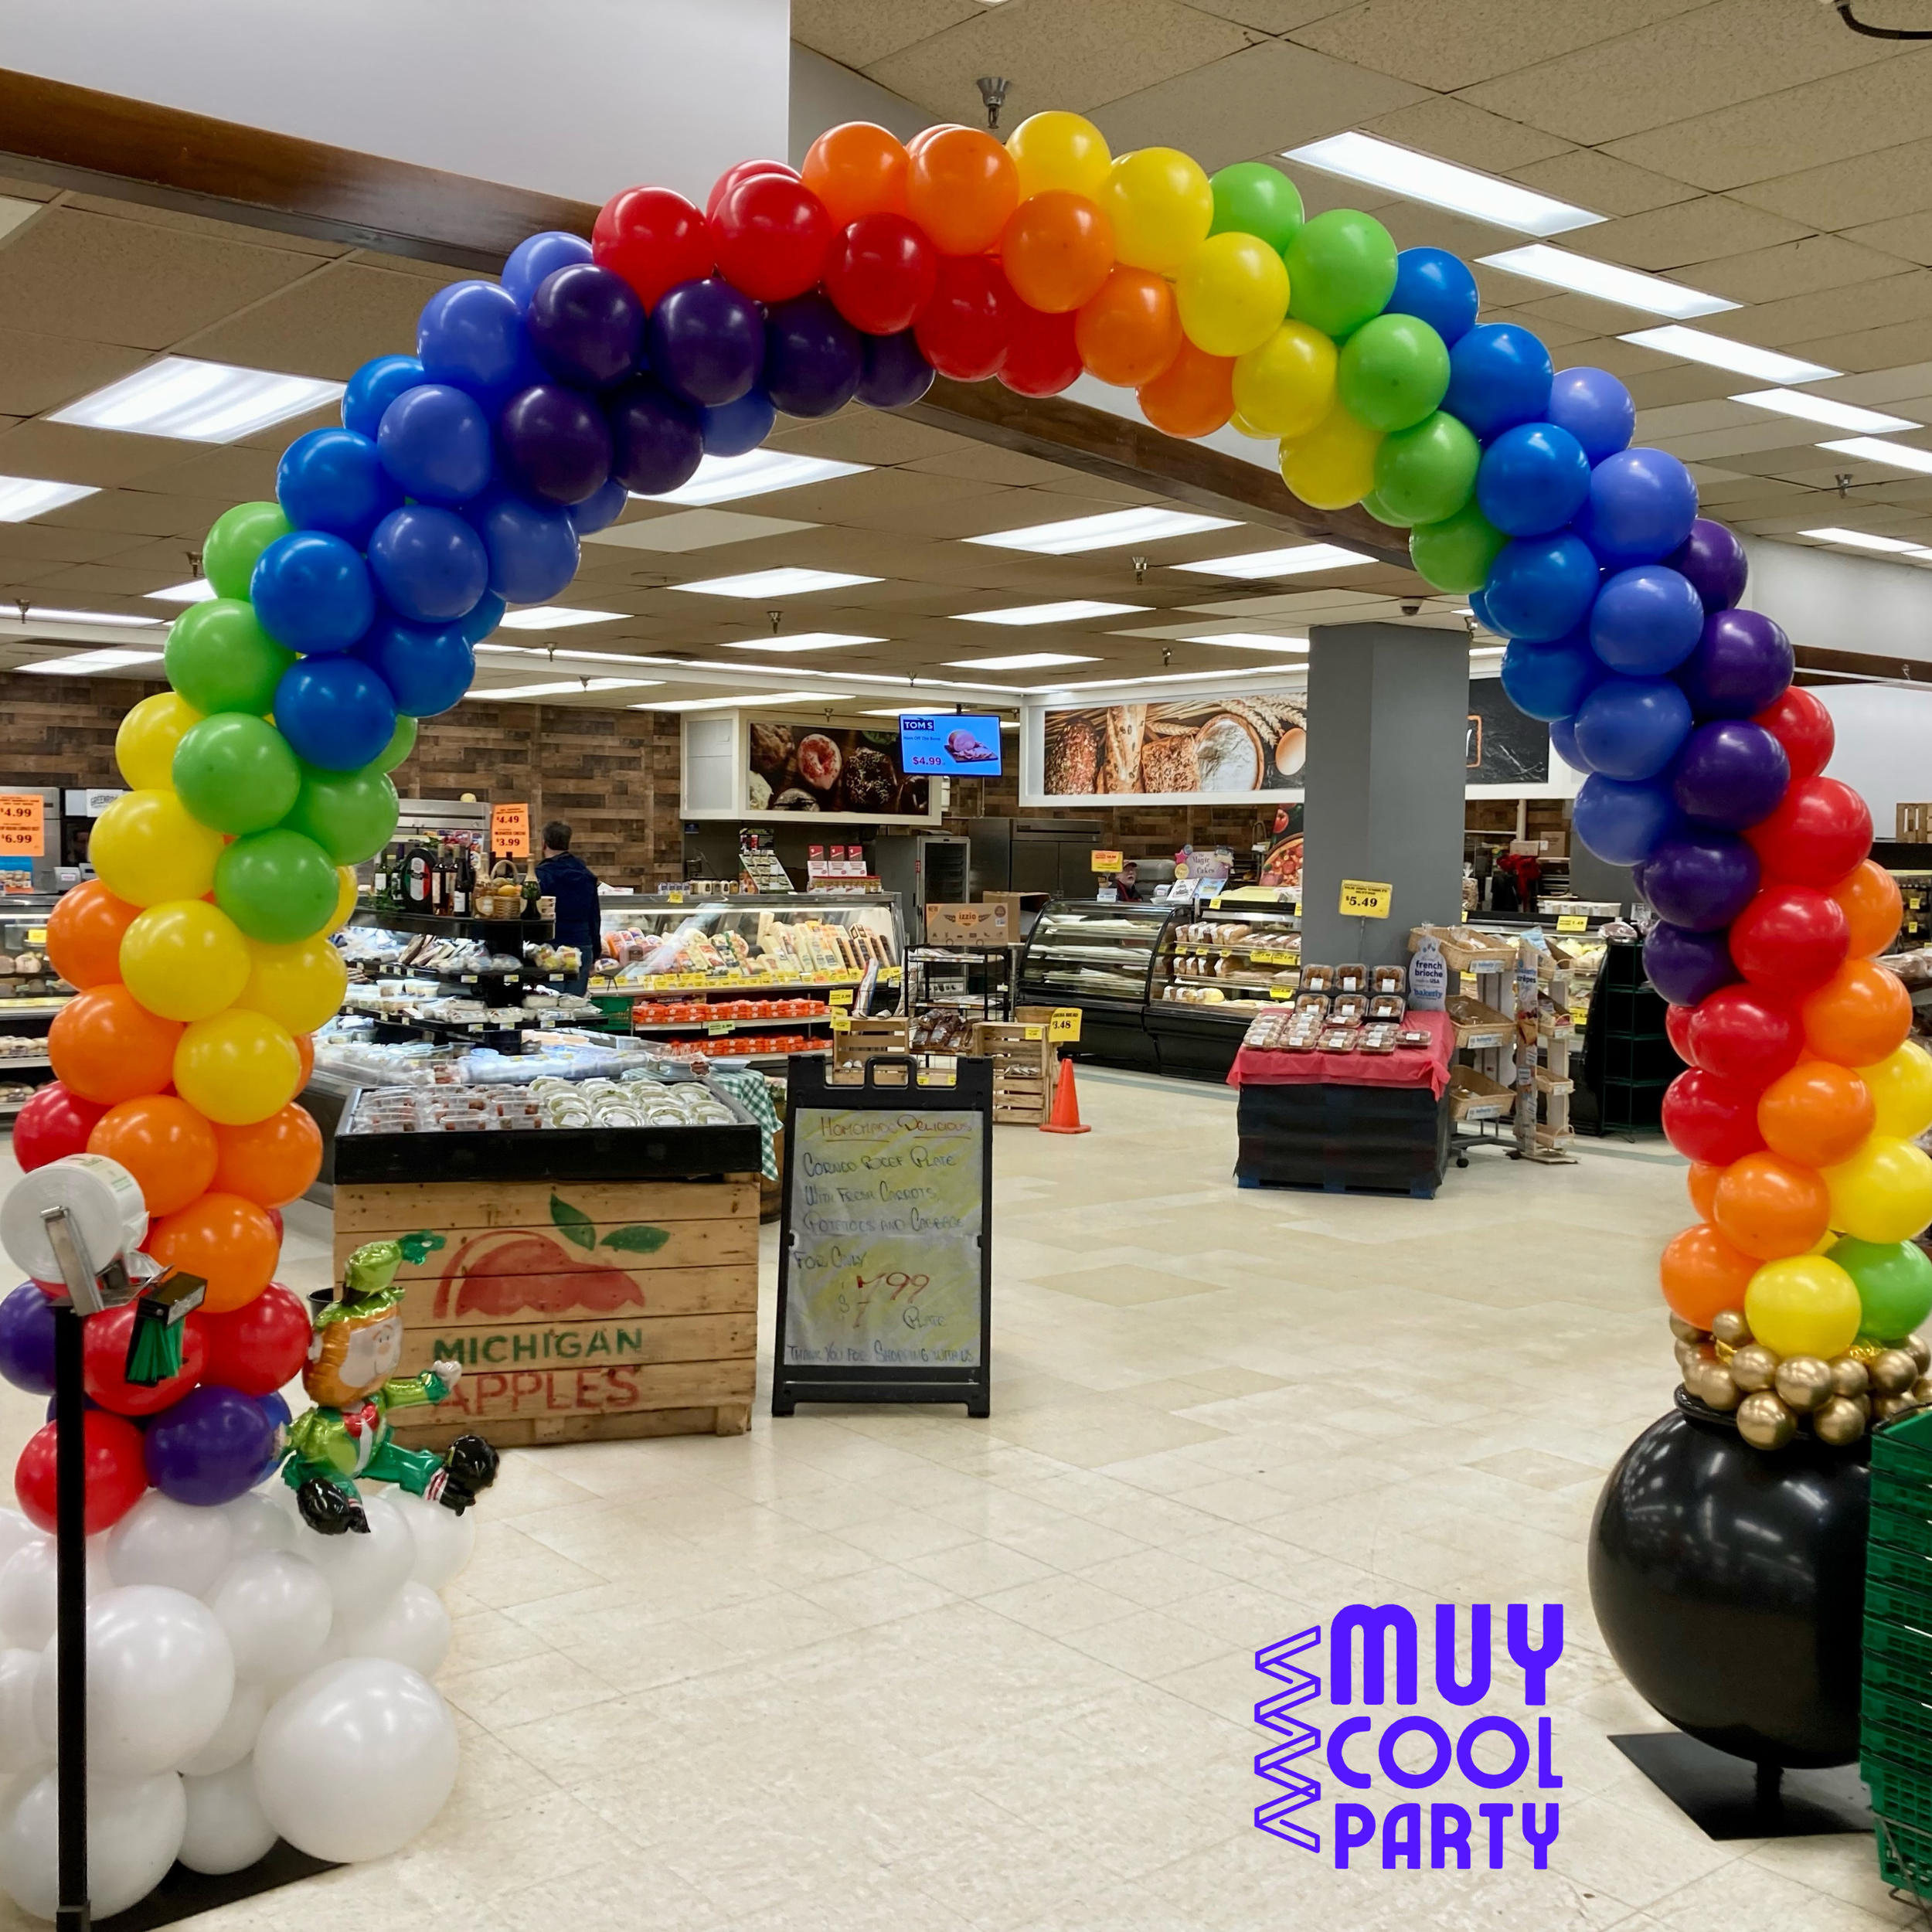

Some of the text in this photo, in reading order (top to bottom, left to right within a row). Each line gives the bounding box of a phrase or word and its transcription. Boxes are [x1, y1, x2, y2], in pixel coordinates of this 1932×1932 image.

[913, 757, 941, 765] $4.99
[2, 834, 32, 843] $6.99
[496, 838, 520, 846] $3.99
[1192, 855, 1210, 865] Magic
[1345, 896, 1378, 907] $5.49
[1416, 960, 1443, 970] french
[1414, 968, 1444, 978] brioche
[1413, 988, 1443, 1000] bakerly
[433, 1328, 643, 1364] MICHIGAN
[431, 1365, 641, 1417] APPLES
